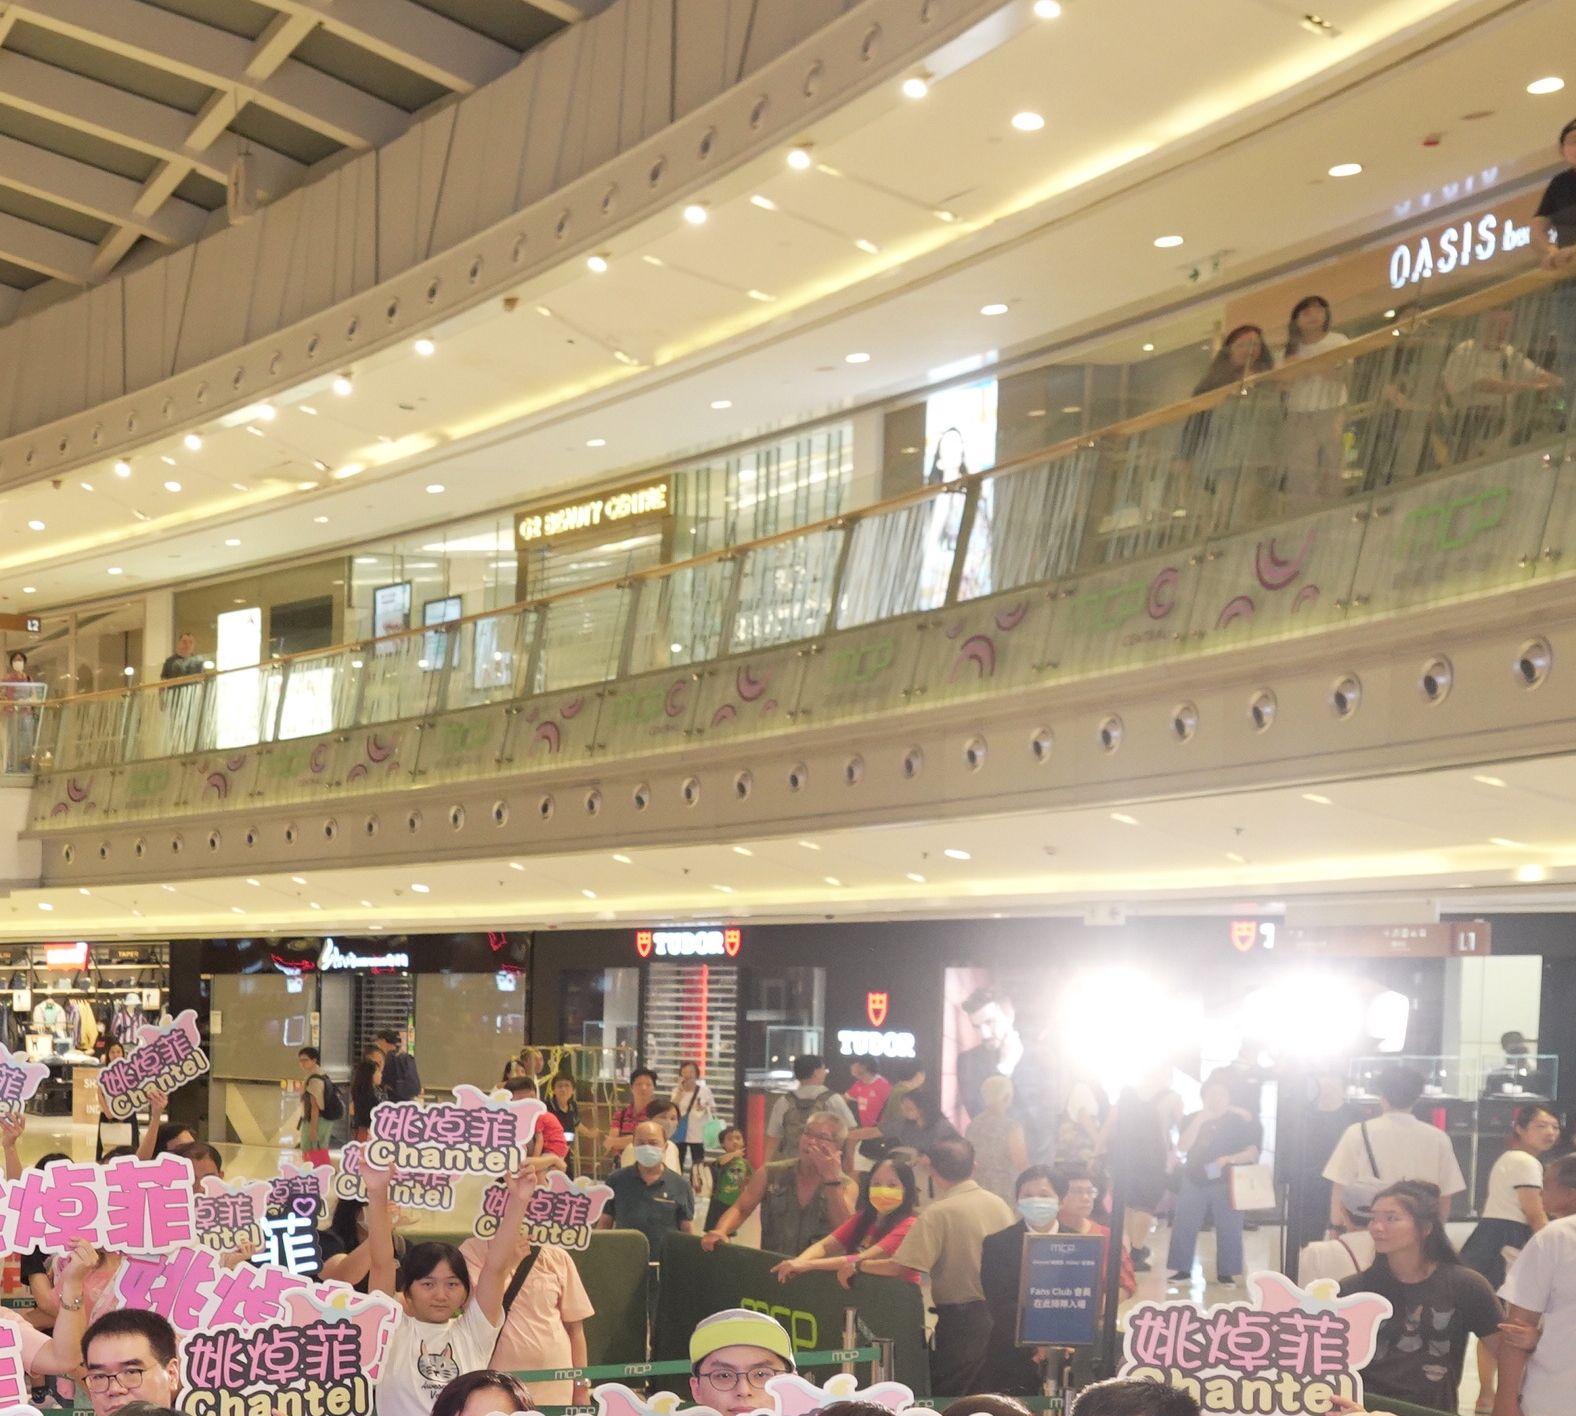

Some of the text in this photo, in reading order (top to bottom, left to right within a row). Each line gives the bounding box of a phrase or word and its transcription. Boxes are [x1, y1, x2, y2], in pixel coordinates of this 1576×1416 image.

[1388, 213, 1498, 290] OASIS
[652, 930, 725, 957] TUDOR
[102, 1027, 192, 1096] 姚焯菲
[837, 1029, 917, 1059] TUDOR
[112, 1055, 205, 1114] Chantel
[377, 1108, 513, 1146] 姚焯菲
[370, 1141, 518, 1172] Chantel
[1030, 1286, 1051, 1297] Fans
[1052, 1286, 1073, 1297] Club
[189, 1324, 362, 1387] 姚焯菲
[1135, 1312, 1348, 1375] 姚焯菲
